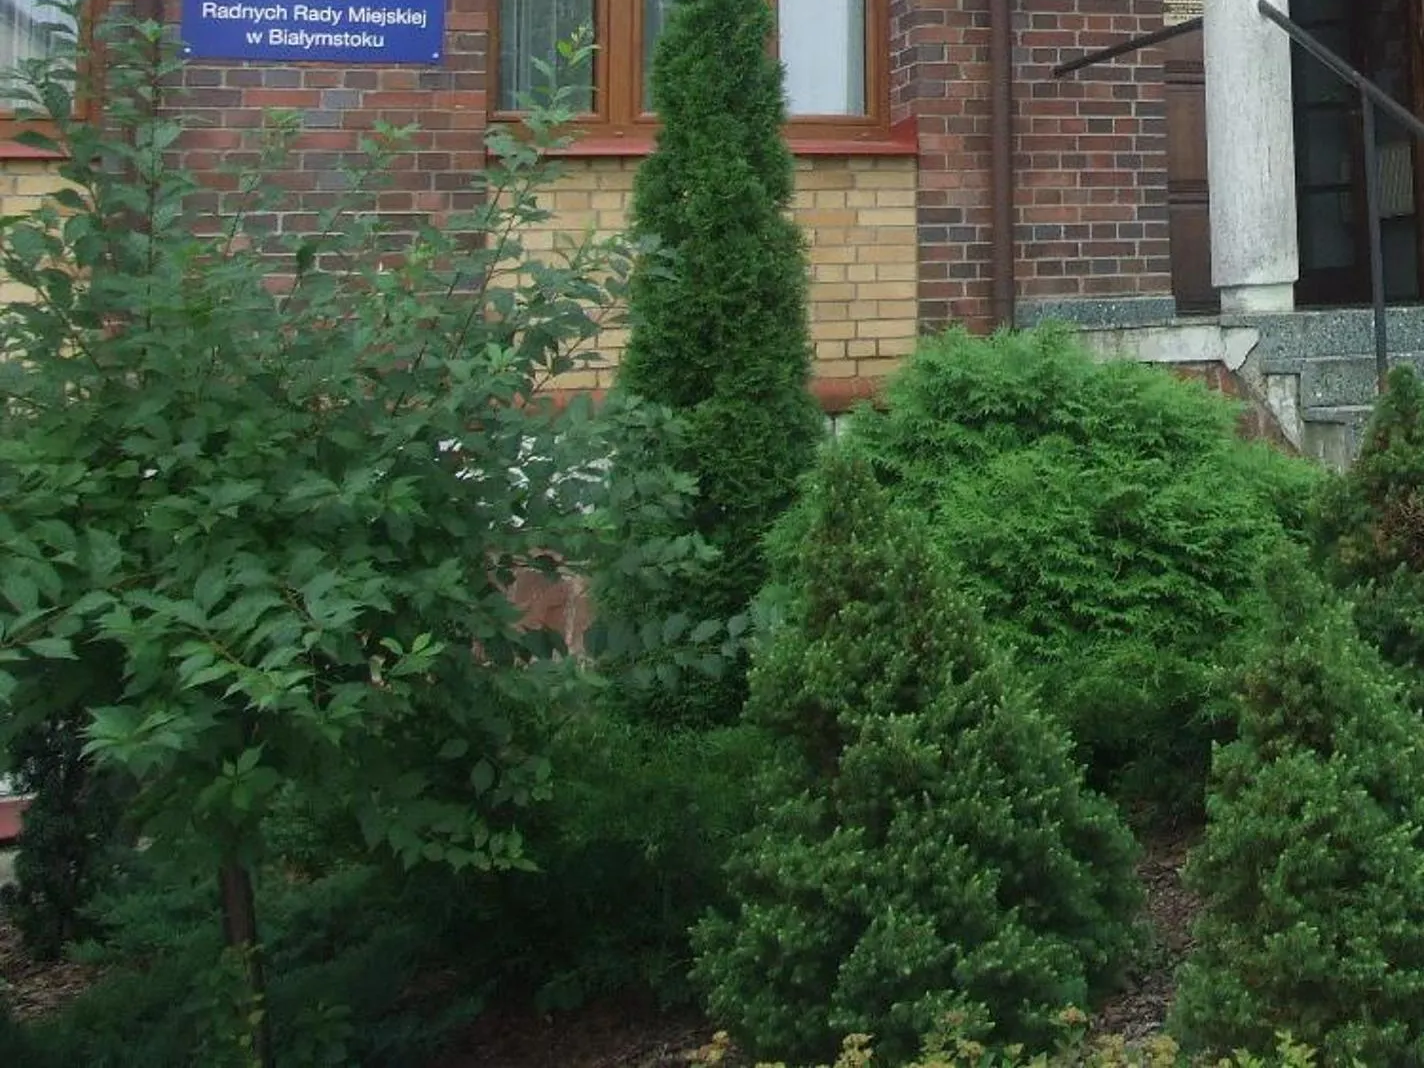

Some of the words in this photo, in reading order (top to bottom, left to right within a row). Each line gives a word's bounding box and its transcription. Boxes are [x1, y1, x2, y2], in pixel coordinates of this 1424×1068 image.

[201, 2, 288, 24] Radnych
[293, 4, 343, 27] Rady
[348, 7, 428, 29] Miejskiej
[246, 31, 263, 45] w
[268, 29, 385, 50] Białymstoku
